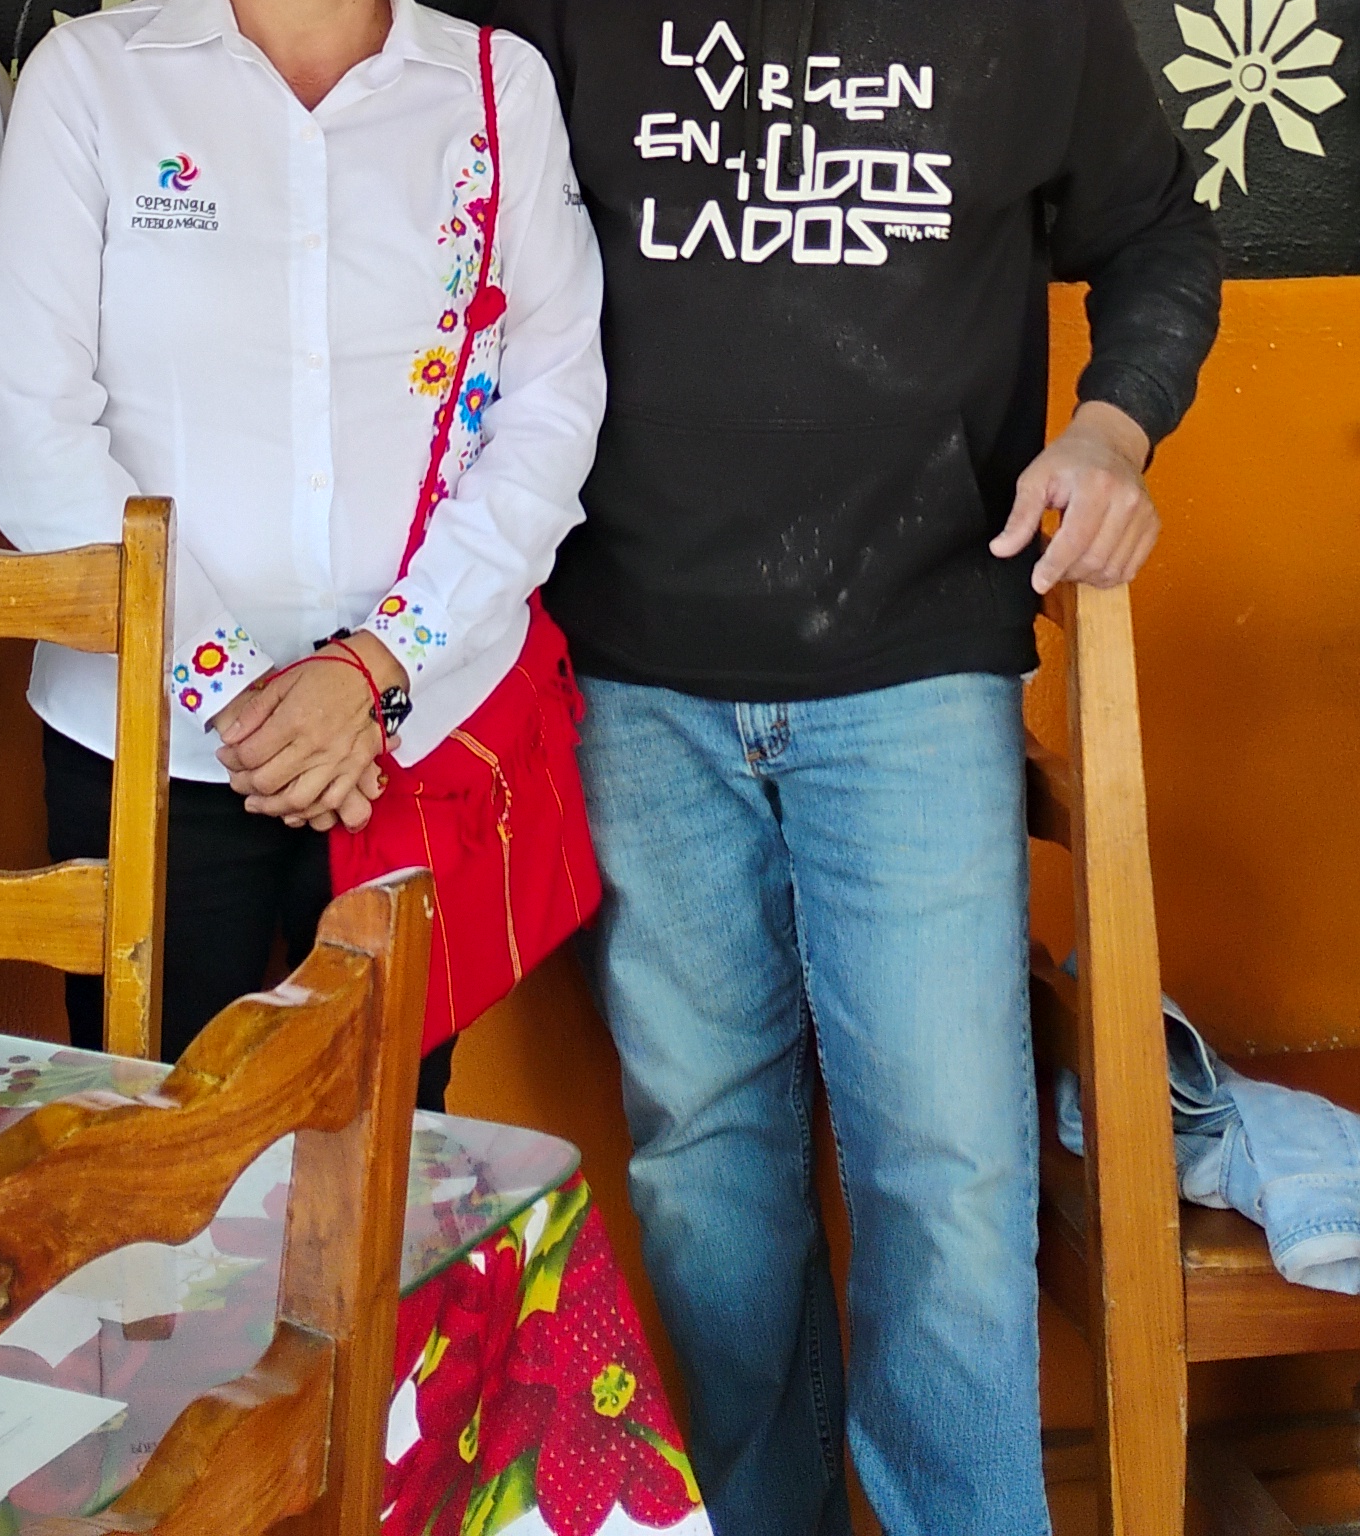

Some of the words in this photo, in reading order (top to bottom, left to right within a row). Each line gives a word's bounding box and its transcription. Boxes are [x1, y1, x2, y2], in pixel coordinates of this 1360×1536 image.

[660, 20, 745, 67] LA
[633, 112, 720, 164] EN
[640, 197, 952, 266] LADOS
